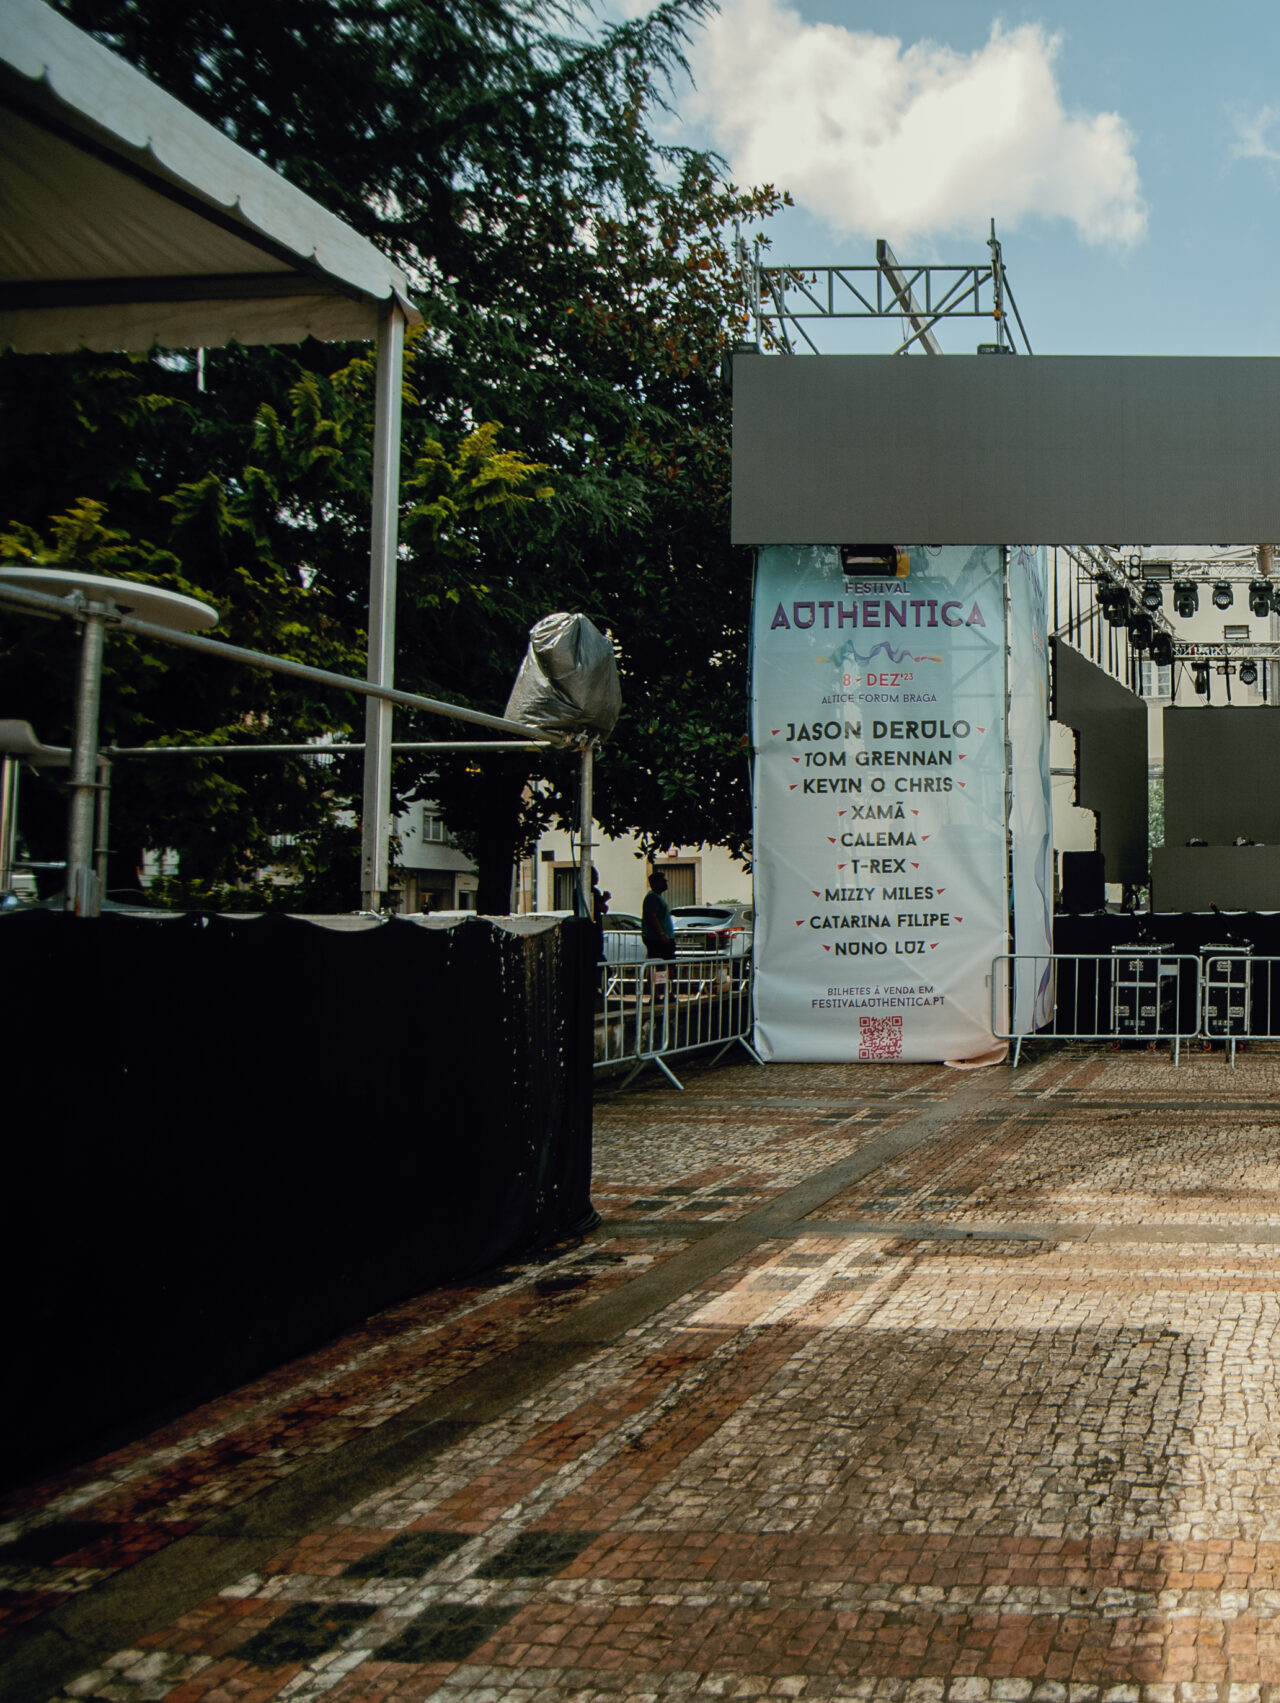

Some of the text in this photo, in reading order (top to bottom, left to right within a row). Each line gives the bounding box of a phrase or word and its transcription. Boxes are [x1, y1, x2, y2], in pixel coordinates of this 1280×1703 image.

[845, 582, 910, 596] FESTIVAL
[770, 599, 986, 630] AUTHENTICA
[843, 673, 851, 686] 8
[821, 693, 937, 705] ALTICE FORUM BRAGA
[786, 719, 971, 742] JASON DERULO
[805, 750, 953, 767] TOM GRENNAN
[803, 777, 953, 794] KEVIN O CHRIS
[851, 801, 905, 820] XAMÃ
[841, 832, 917, 846] CALEMA
[851, 859, 907, 874] T-REX
[824, 887, 934, 901] MIZZY MILES
[810, 913, 950, 929] CATARINA FILIPE
[835, 941, 926, 955] NUNO LUZ
[828, 986, 871, 995] BILHETES
[883, 986, 915, 995] VENDA
[918, 986, 934, 994] EM
[812, 996, 945, 1009] FESTIVALAUTHENTICA.PT
